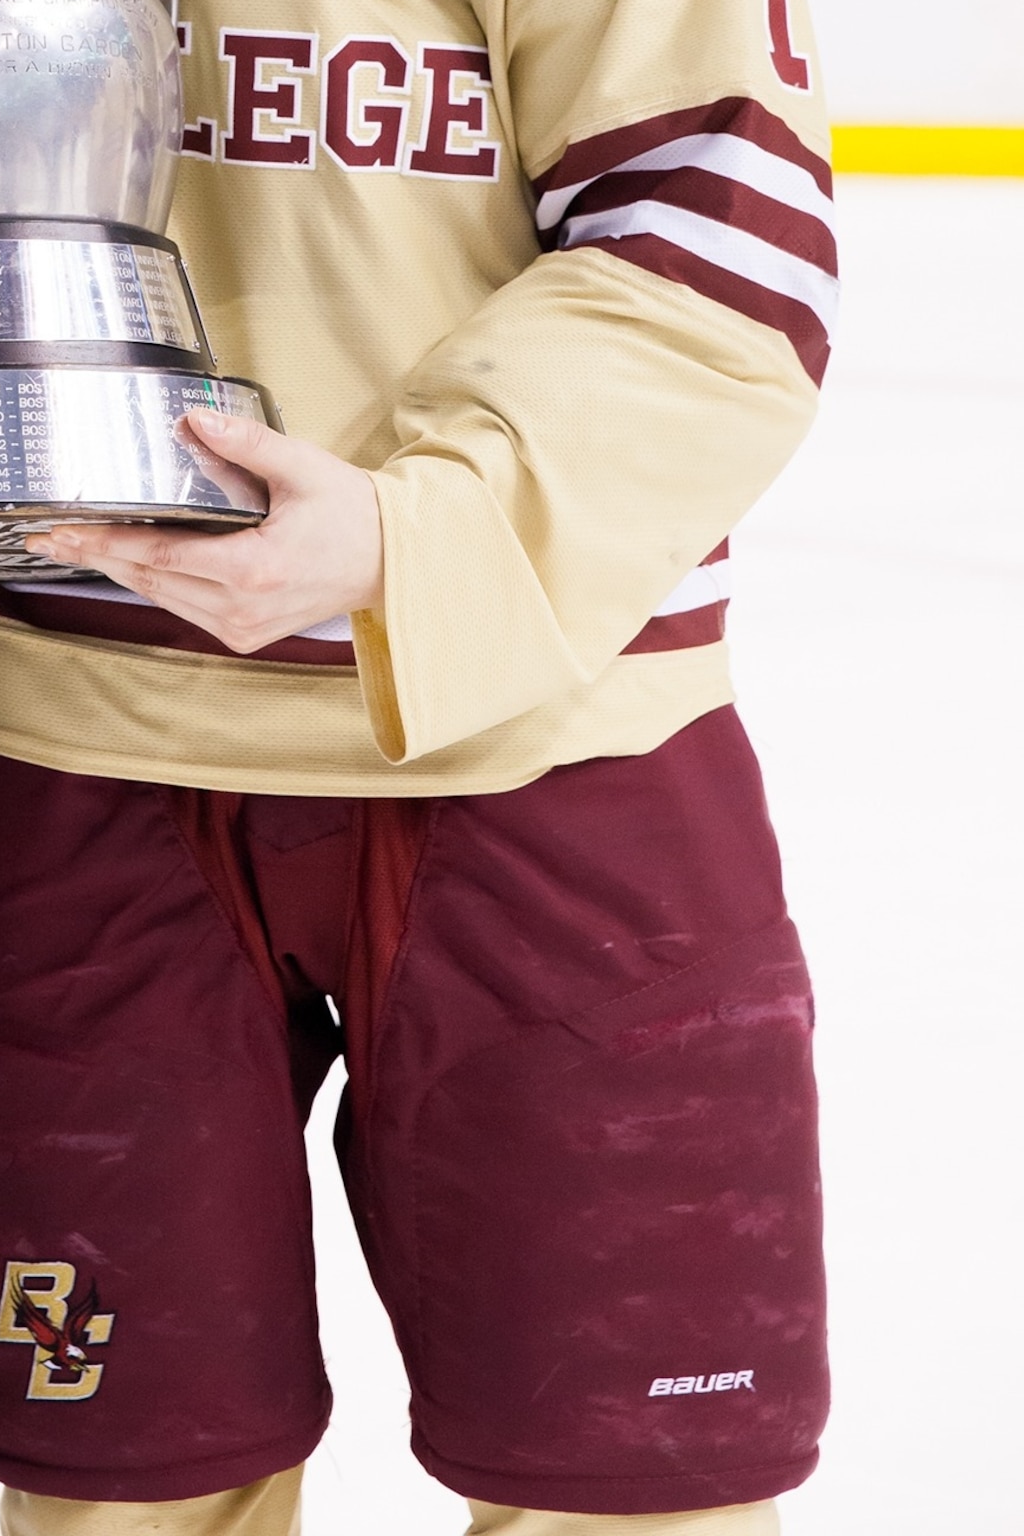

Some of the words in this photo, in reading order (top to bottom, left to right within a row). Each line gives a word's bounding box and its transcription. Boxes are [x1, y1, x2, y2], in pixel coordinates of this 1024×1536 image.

[61, 34, 143, 62] GARDEN
[181, 387, 213, 402] BOSTO
[648, 1369, 755, 1397] BAUER
